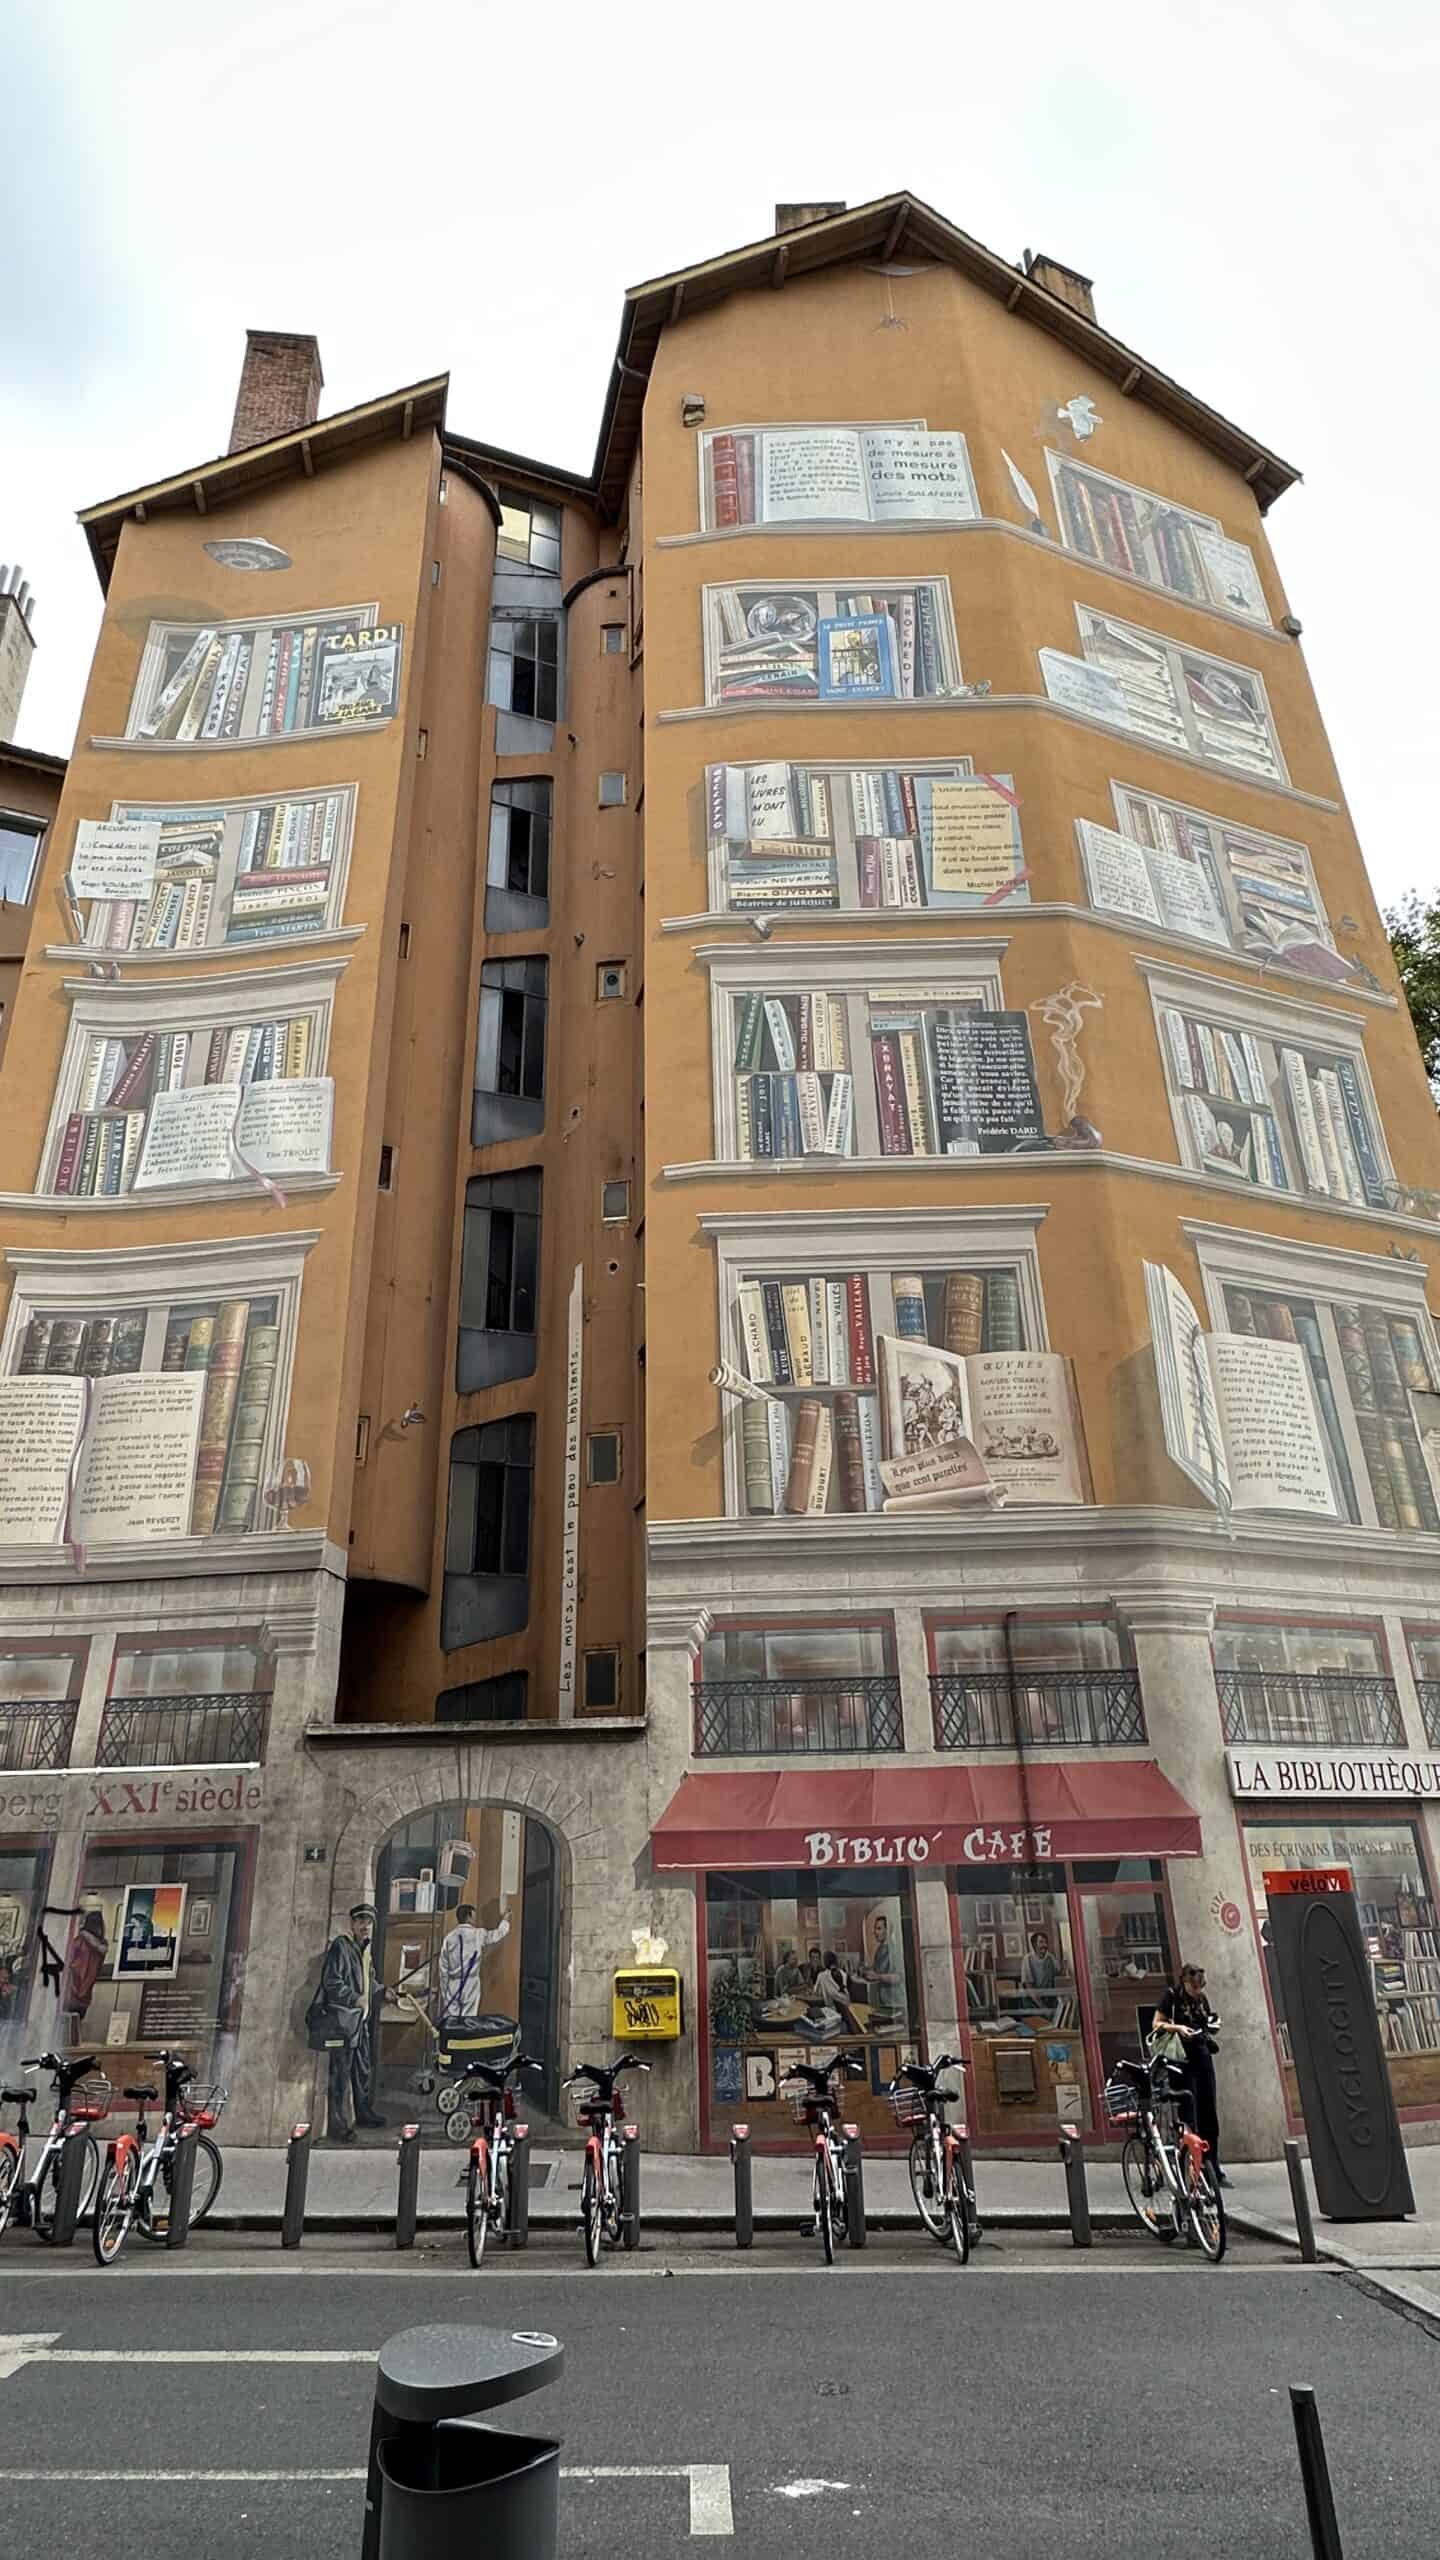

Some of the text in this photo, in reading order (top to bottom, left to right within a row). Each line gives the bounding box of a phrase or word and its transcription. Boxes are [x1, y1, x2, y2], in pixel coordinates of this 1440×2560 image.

[872, 470, 905, 480] des
[327, 626, 398, 650] TARDI
[751, 774, 768, 784] LES
[751, 787, 786, 798] LIVRES
[1010, 1127, 1038, 1135] DARD
[748, 1312, 761, 1354] ACHARD
[565, 1435, 577, 1461] des
[567, 1473, 580, 1508] peau
[560, 1661, 572, 1692] Les
[1234, 1761, 1271, 1791] LA
[176, 1775, 262, 1813] siècle
